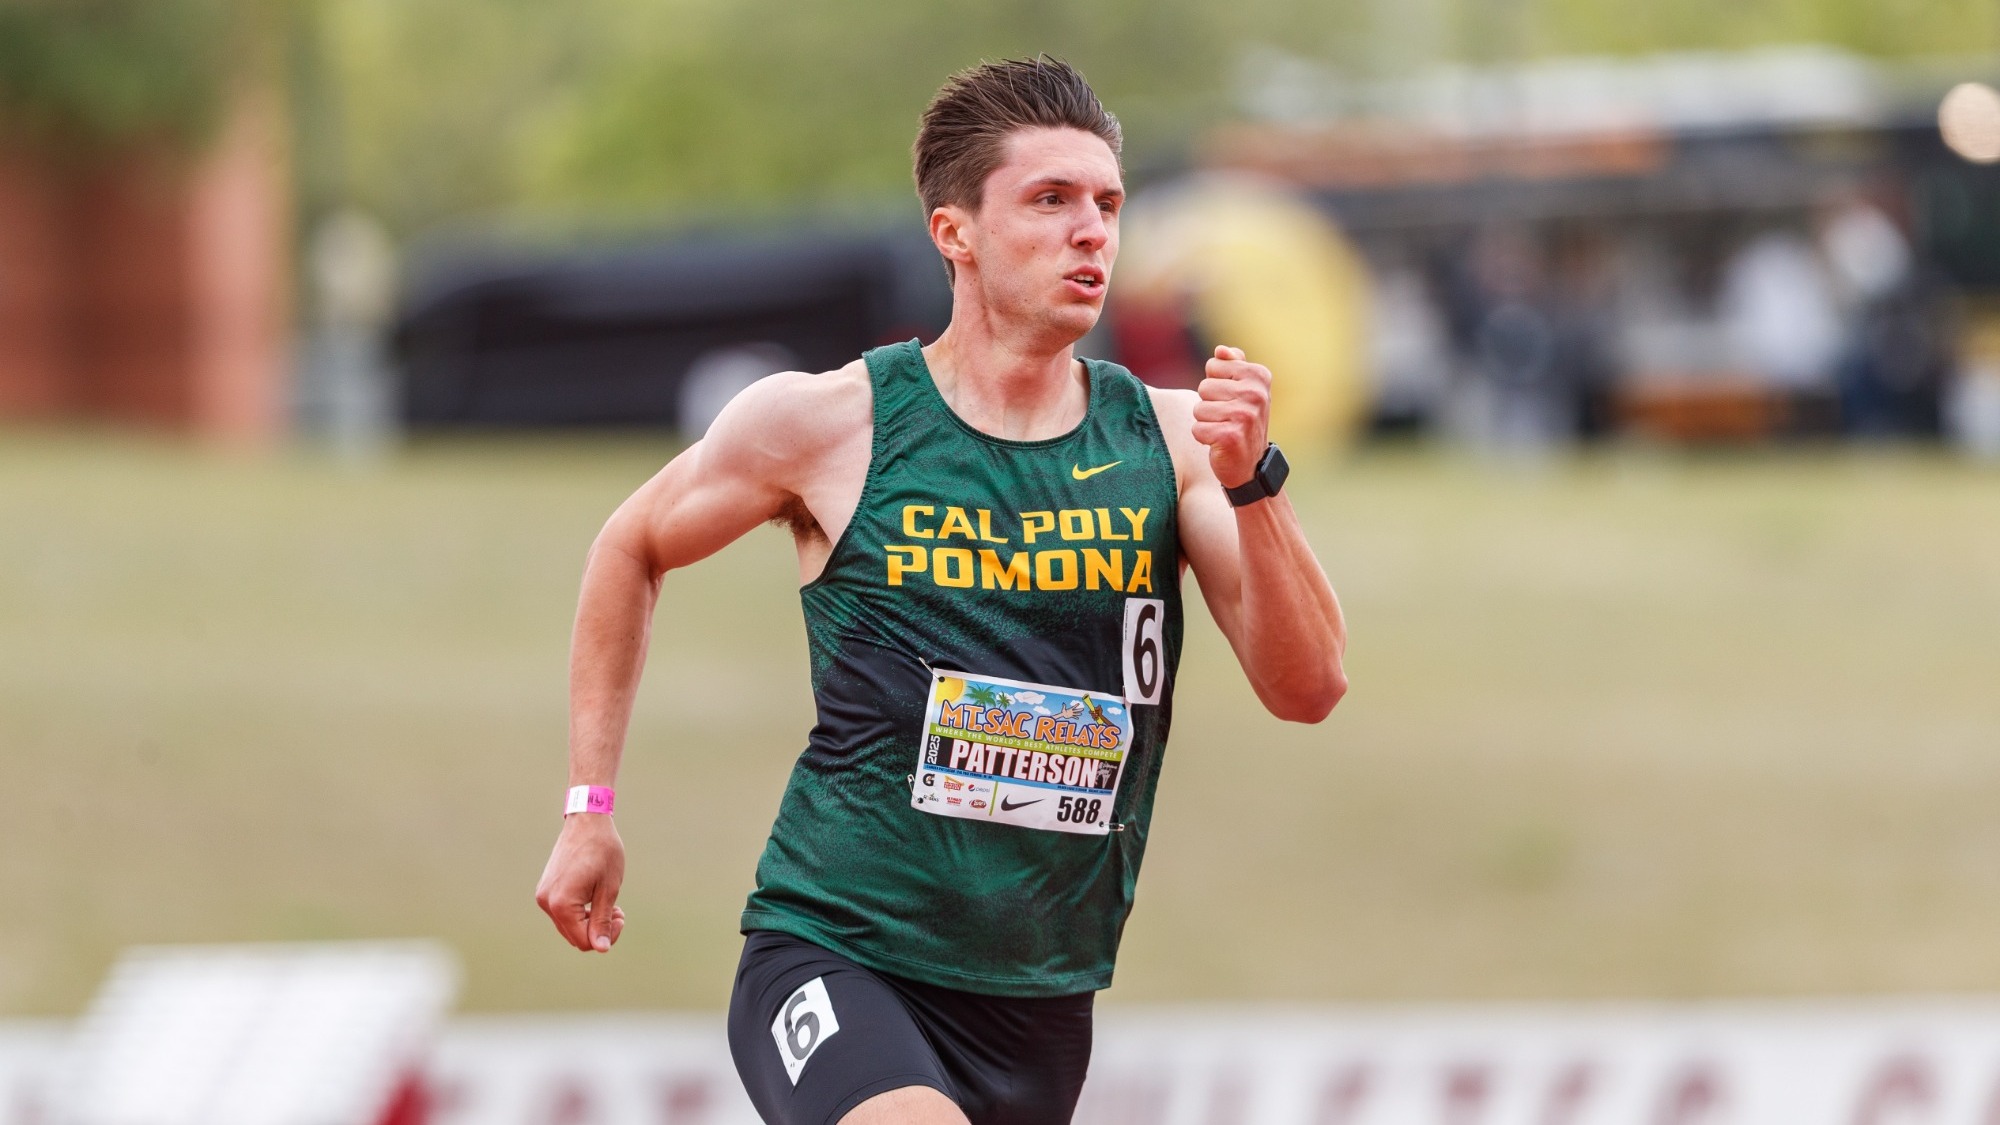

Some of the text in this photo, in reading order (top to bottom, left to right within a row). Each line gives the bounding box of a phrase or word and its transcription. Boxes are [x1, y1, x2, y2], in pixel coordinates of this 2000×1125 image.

[903, 505, 1151, 544] CAL POLY
[883, 545, 1153, 593] POMONA
[1133, 604, 1158, 699] 6
[927, 735, 941, 765] 2025
[935, 726, 1118, 759] WHERE THE WORLD'S BEST ATHLETES COMPETE
[1034, 715, 1122, 750] RELAYS
[949, 738, 1100, 788] PATTERSON
[1056, 795, 1102, 825] 588
[784, 990, 821, 1061] 6
